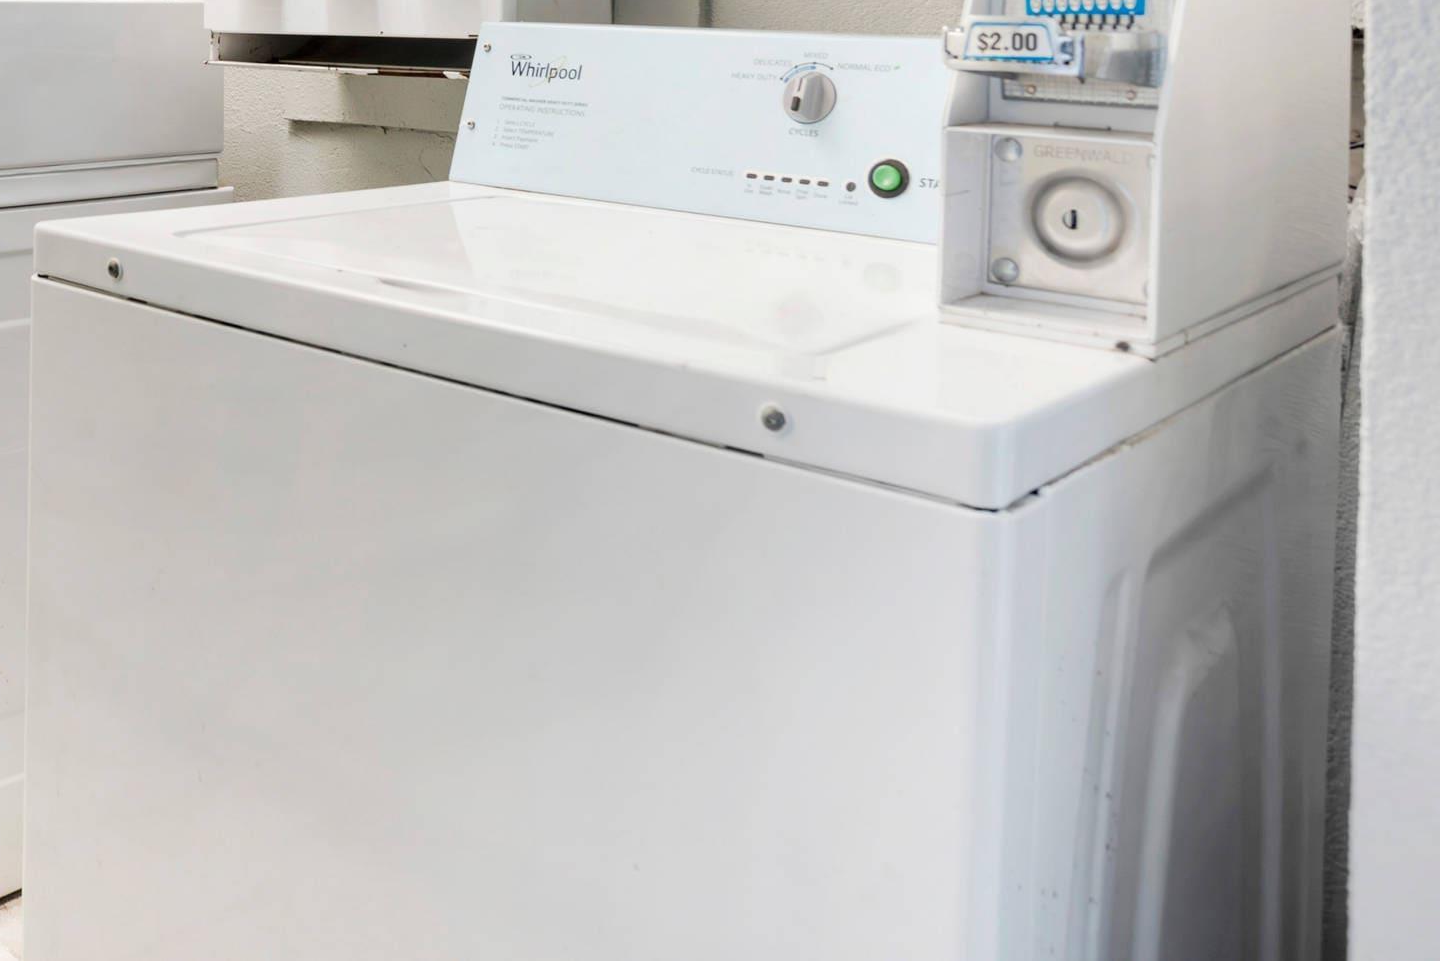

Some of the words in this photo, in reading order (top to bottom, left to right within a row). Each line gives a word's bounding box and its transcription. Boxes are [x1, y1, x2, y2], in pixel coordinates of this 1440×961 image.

[976, 32, 1038, 52] $2.00
[511, 61, 583, 83] Whirlpool
[788, 128, 819, 138] CYCLES
[1033, 144, 1134, 164] GREENWALD
